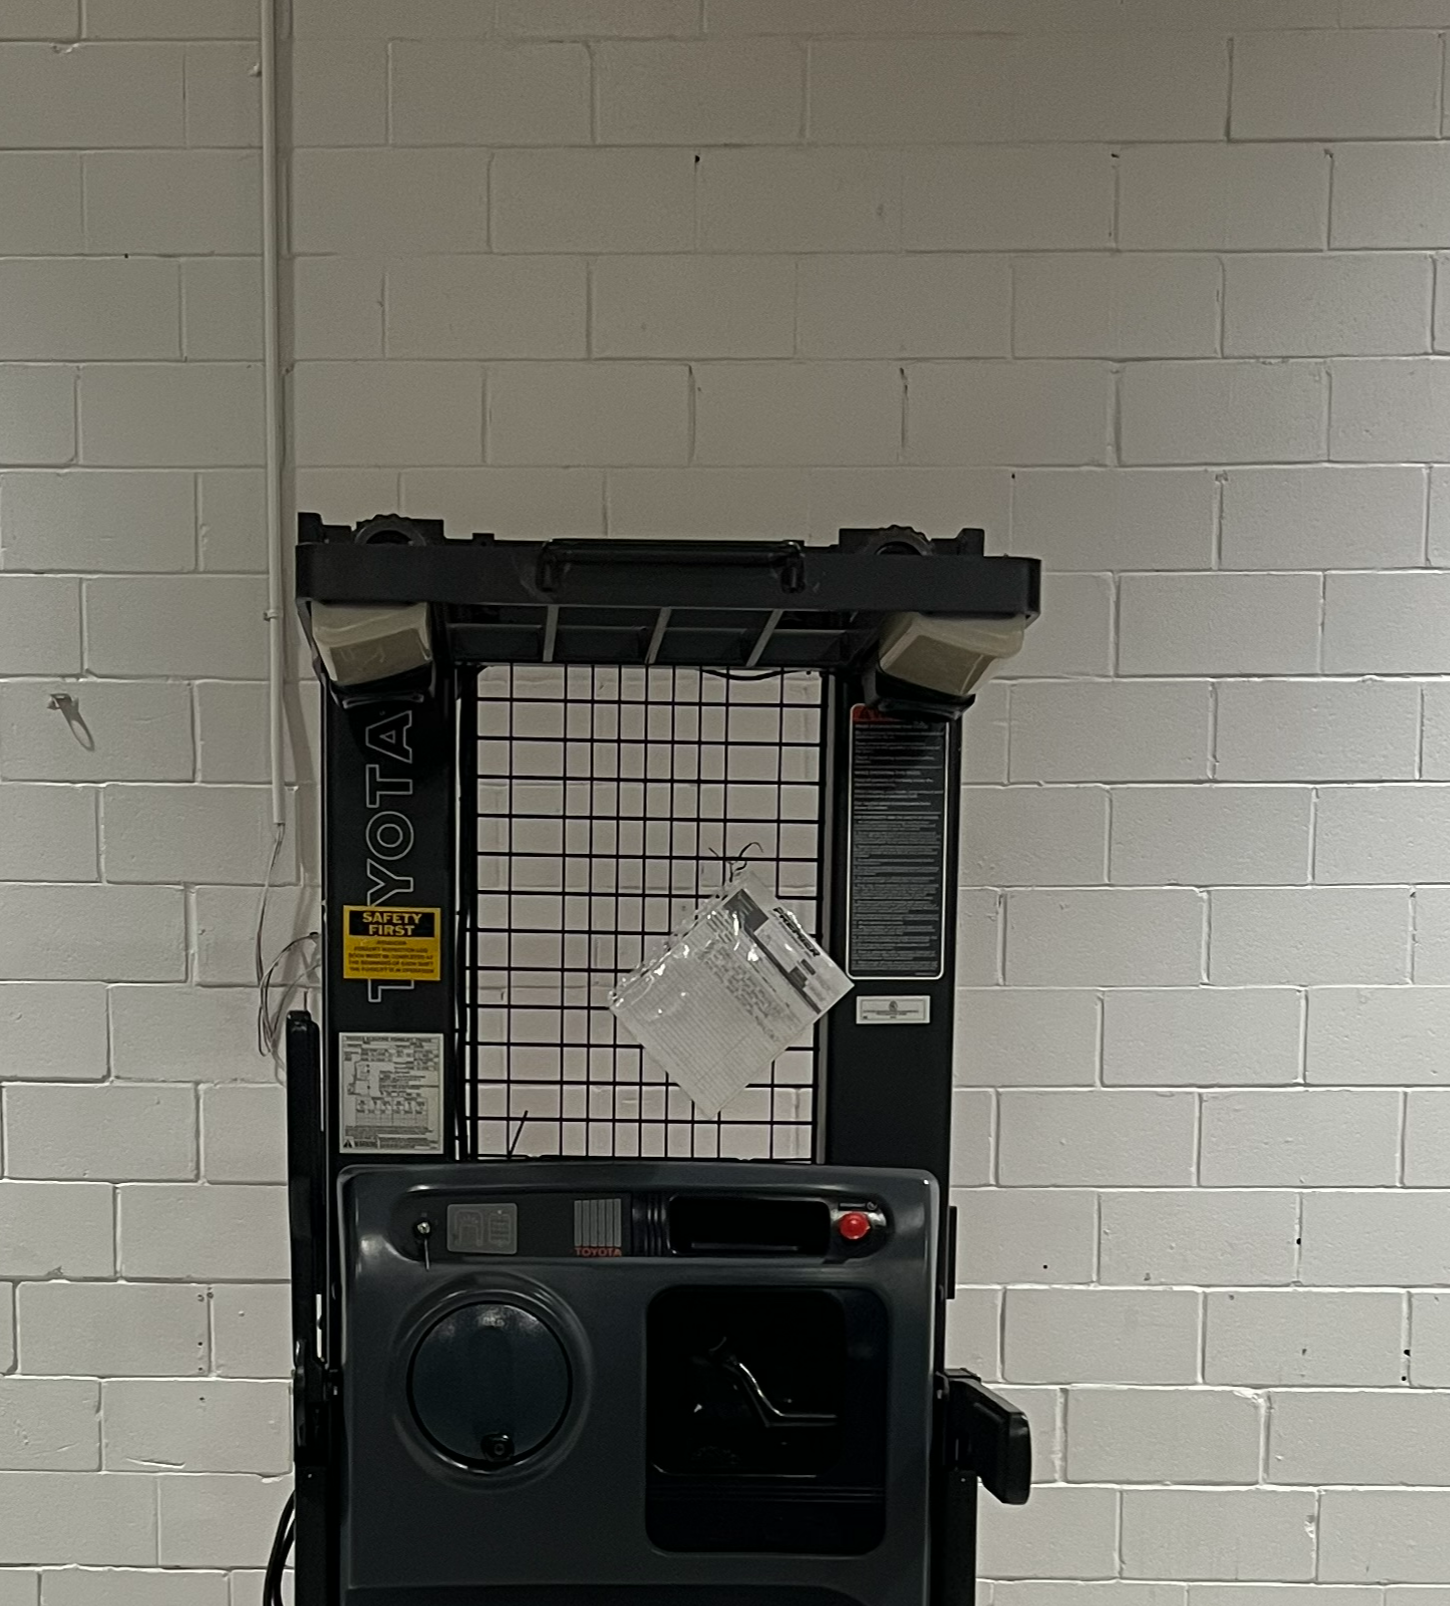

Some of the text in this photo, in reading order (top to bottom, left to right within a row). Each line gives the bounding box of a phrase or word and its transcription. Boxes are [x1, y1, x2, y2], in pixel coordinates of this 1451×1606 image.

[365, 710, 414, 1002] TYOTA
[362, 911, 422, 924] SAFETY
[368, 924, 415, 936] FIRST
[575, 1247, 622, 1257] TOYOTA
